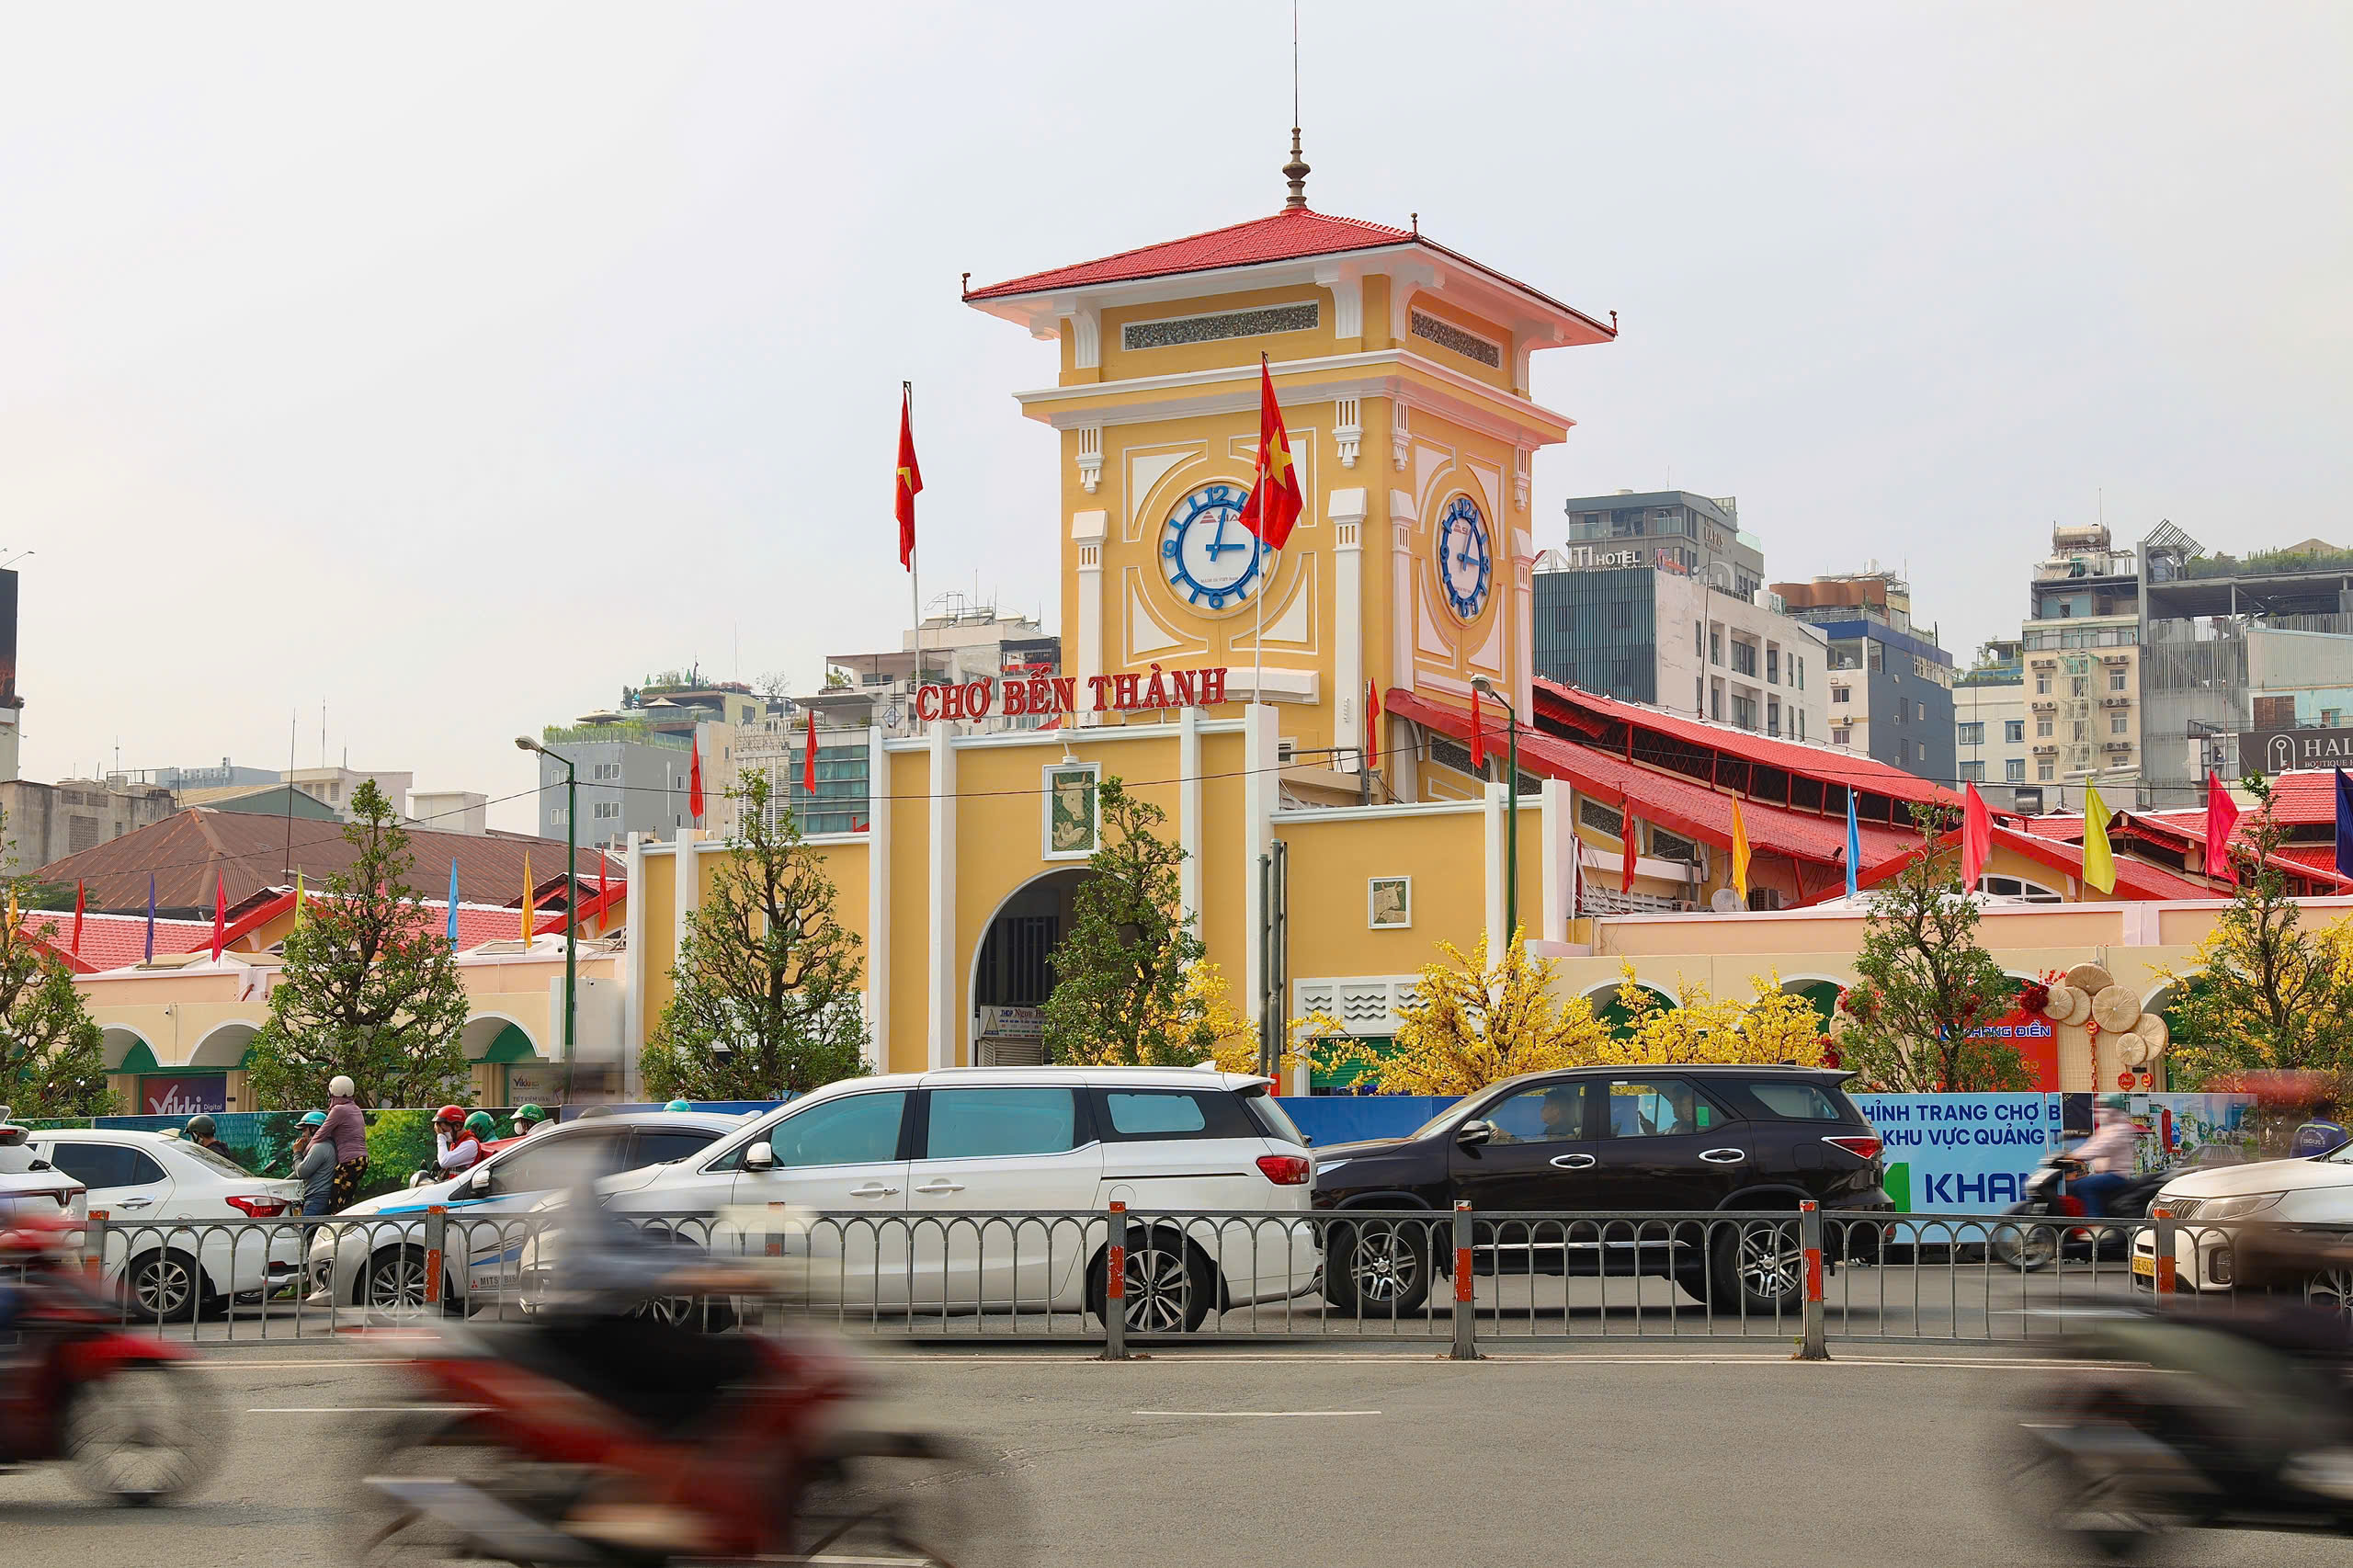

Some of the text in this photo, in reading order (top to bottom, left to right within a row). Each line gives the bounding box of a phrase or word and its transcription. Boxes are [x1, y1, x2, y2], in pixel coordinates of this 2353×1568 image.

[1205, 485, 1229, 506] 12
[1162, 540, 1176, 559] 9
[1597, 551, 1641, 565] HOTEL
[1209, 591, 1223, 609] 6
[915, 663, 1228, 723] CHỢ BẾN THÀNH
[2304, 759, 2347, 767] BOUTIQUE
[2016, 1019, 2052, 1037] ĐIỀN
[514, 1074, 530, 1086] Vikki
[149, 1085, 201, 1114] Vikki
[203, 1103, 222, 1111] Digital
[1916, 1105, 1988, 1121] TRANG
[1995, 1102, 2039, 1125] CHỢ
[1883, 1130, 1922, 1146] KHU
[1927, 1127, 1971, 1150] VỰC
[1974, 1122, 2045, 1145] QUẢNG
